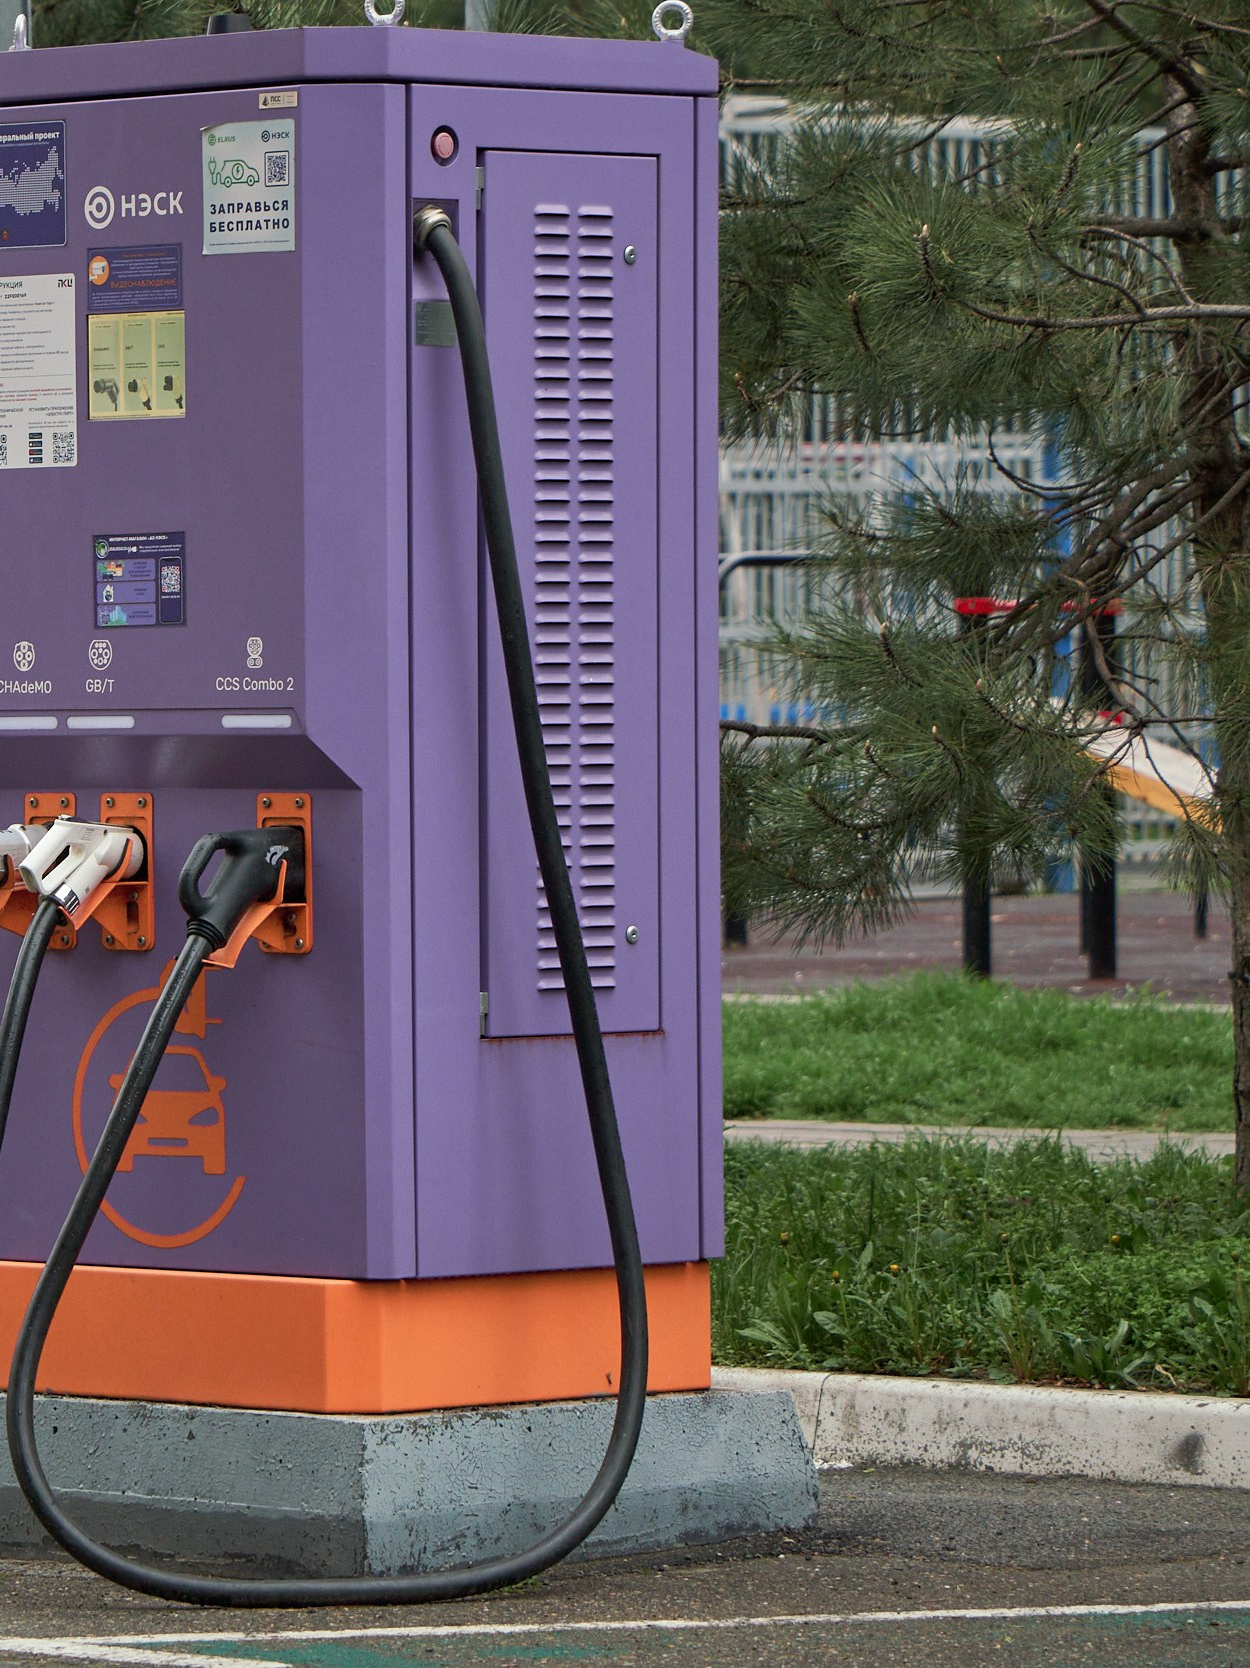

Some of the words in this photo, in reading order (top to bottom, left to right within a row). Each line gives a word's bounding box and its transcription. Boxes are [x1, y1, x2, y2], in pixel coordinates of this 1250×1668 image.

[35, 131, 60, 141] проект
[271, 131, 290, 140] НЭСК
[121, 191, 183, 217] НЭСК
[210, 199, 289, 215] ЗАПРАВЬСЯ
[209, 218, 290, 233] БЕСПЛАТНО
[110, 278, 177, 289] ВИДЕОНАБЛЮДЕНИЕ
[85, 678, 115, 694] GB/T
[215, 677, 240, 691] CCS
[242, 677, 284, 691] Combo
[286, 677, 294, 691] 2
